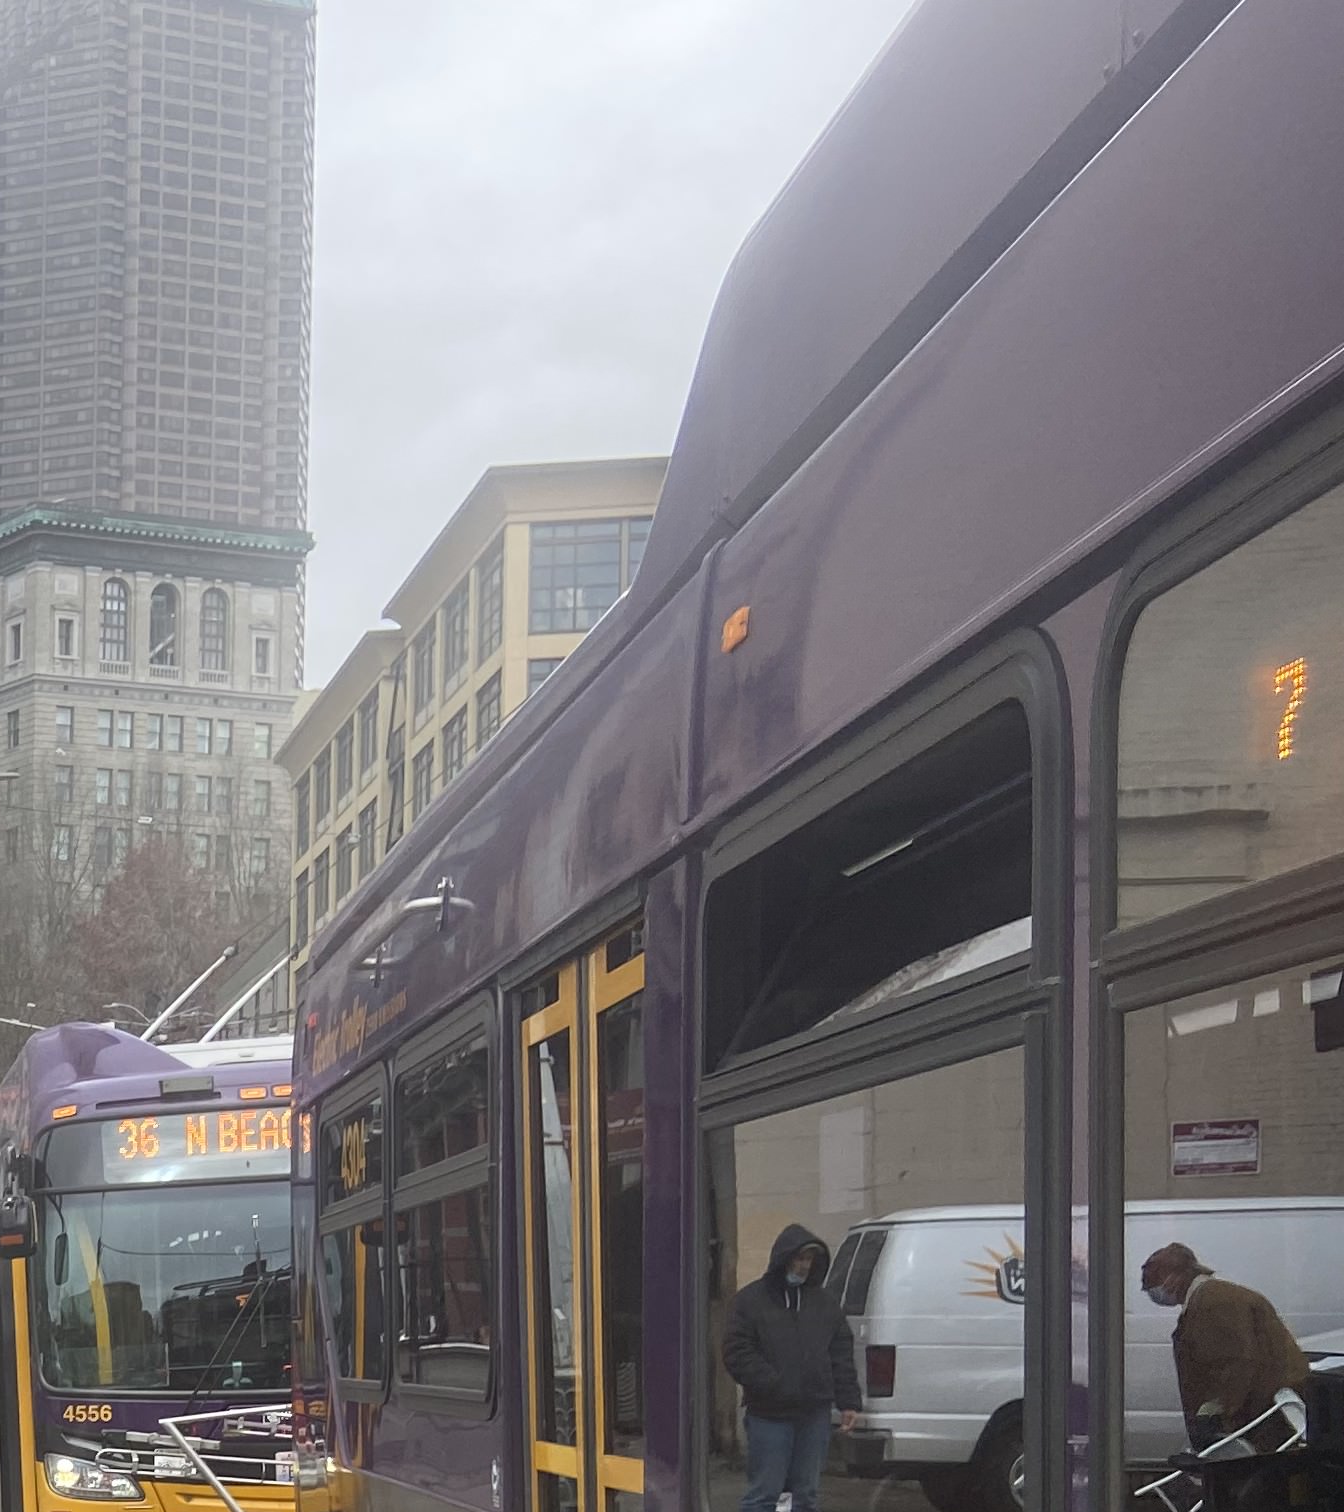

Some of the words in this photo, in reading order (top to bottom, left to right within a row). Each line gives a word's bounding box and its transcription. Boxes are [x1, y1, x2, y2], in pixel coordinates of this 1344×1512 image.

[1275, 657, 1306, 760] 7
[118, 1117, 160, 1159] 36
[185, 1114, 207, 1155] N
[63, 1404, 112, 1422] 4556
